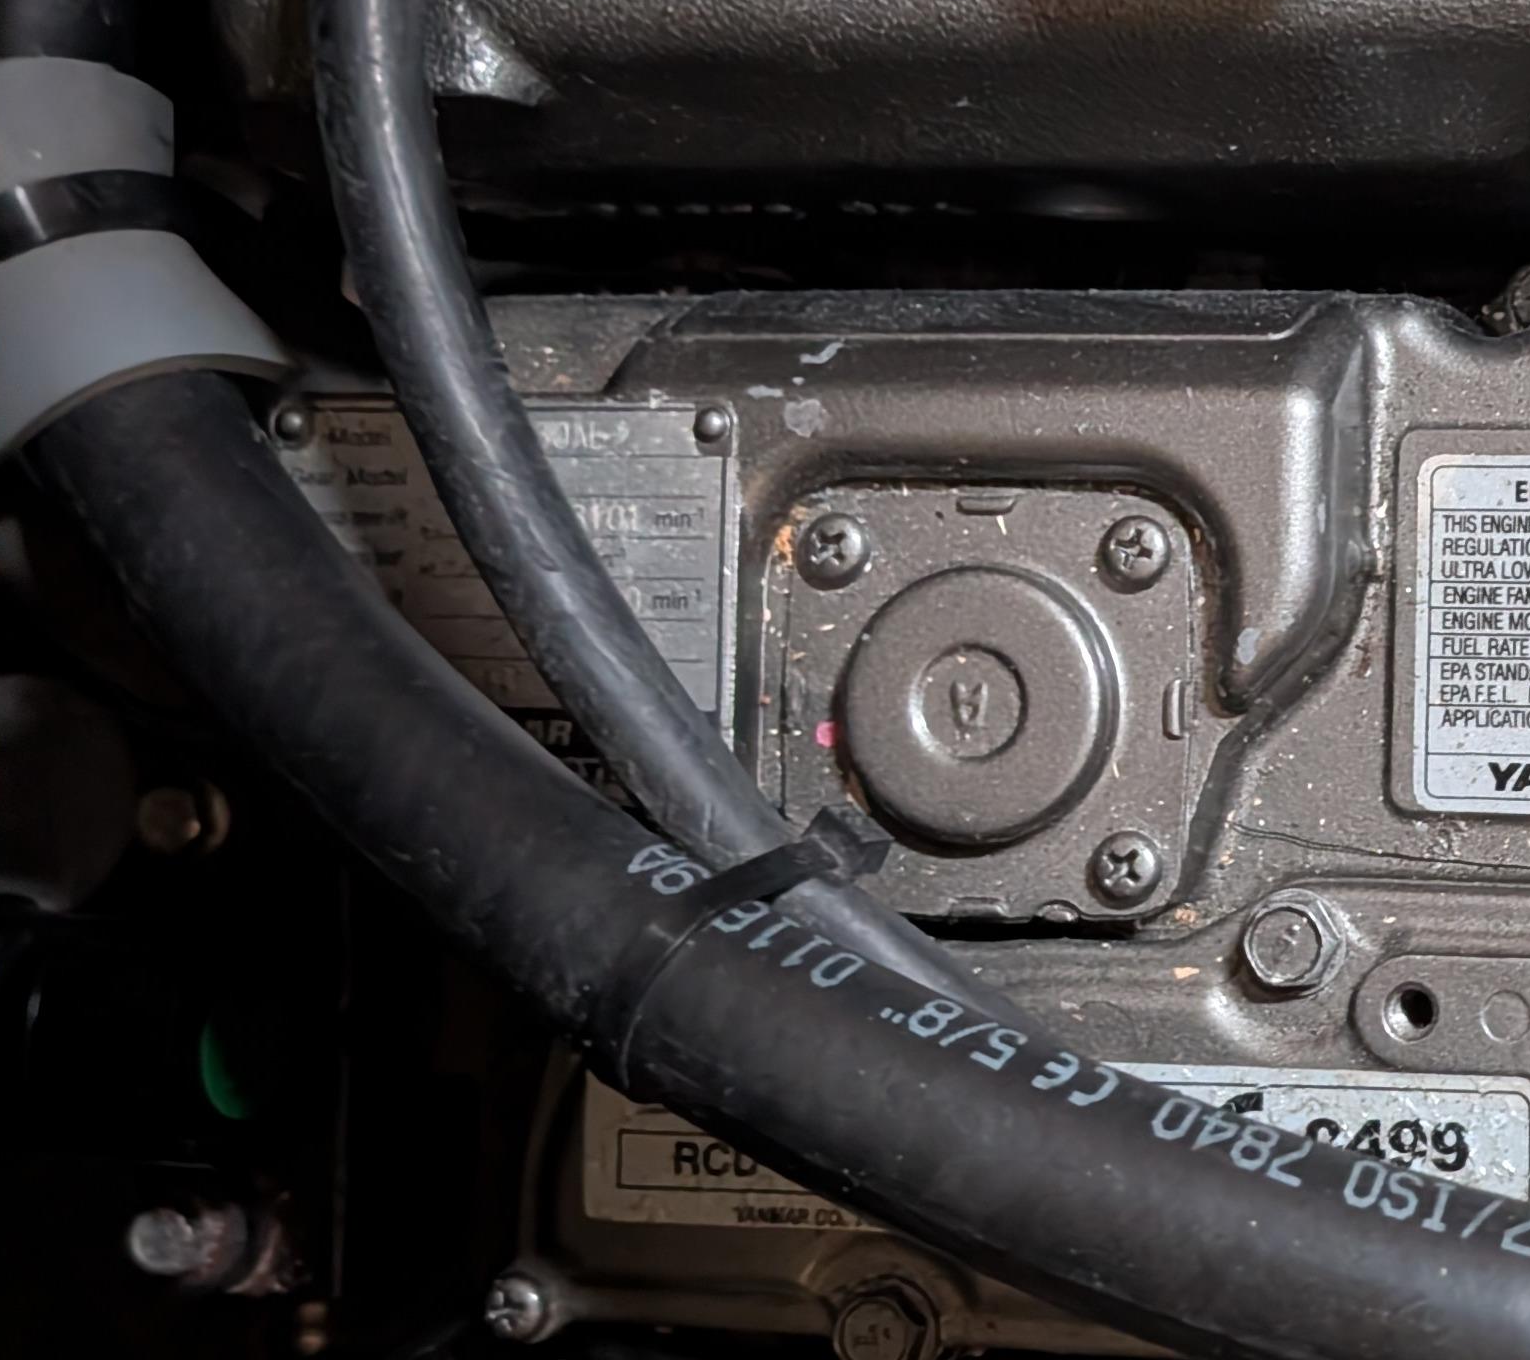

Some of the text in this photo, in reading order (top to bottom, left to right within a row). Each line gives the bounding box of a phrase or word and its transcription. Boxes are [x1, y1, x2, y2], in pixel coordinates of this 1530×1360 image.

[1443, 515, 1476, 533] THIS
[1441, 561, 1497, 579] ULTRA
[1442, 586, 1503, 605] ENGINE
[1442, 612, 1503, 631] ENGINE
[1442, 639, 1483, 656] FUEL
[1488, 639, 1529, 657] RATE
[1440, 663, 1471, 681] EPA
[1440, 685, 1471, 703] EPA
[880, 999, 1028, 1070] 5/8"
[1031, 1051, 1120, 1106] CE
[1151, 1097, 1313, 1187] 7840
